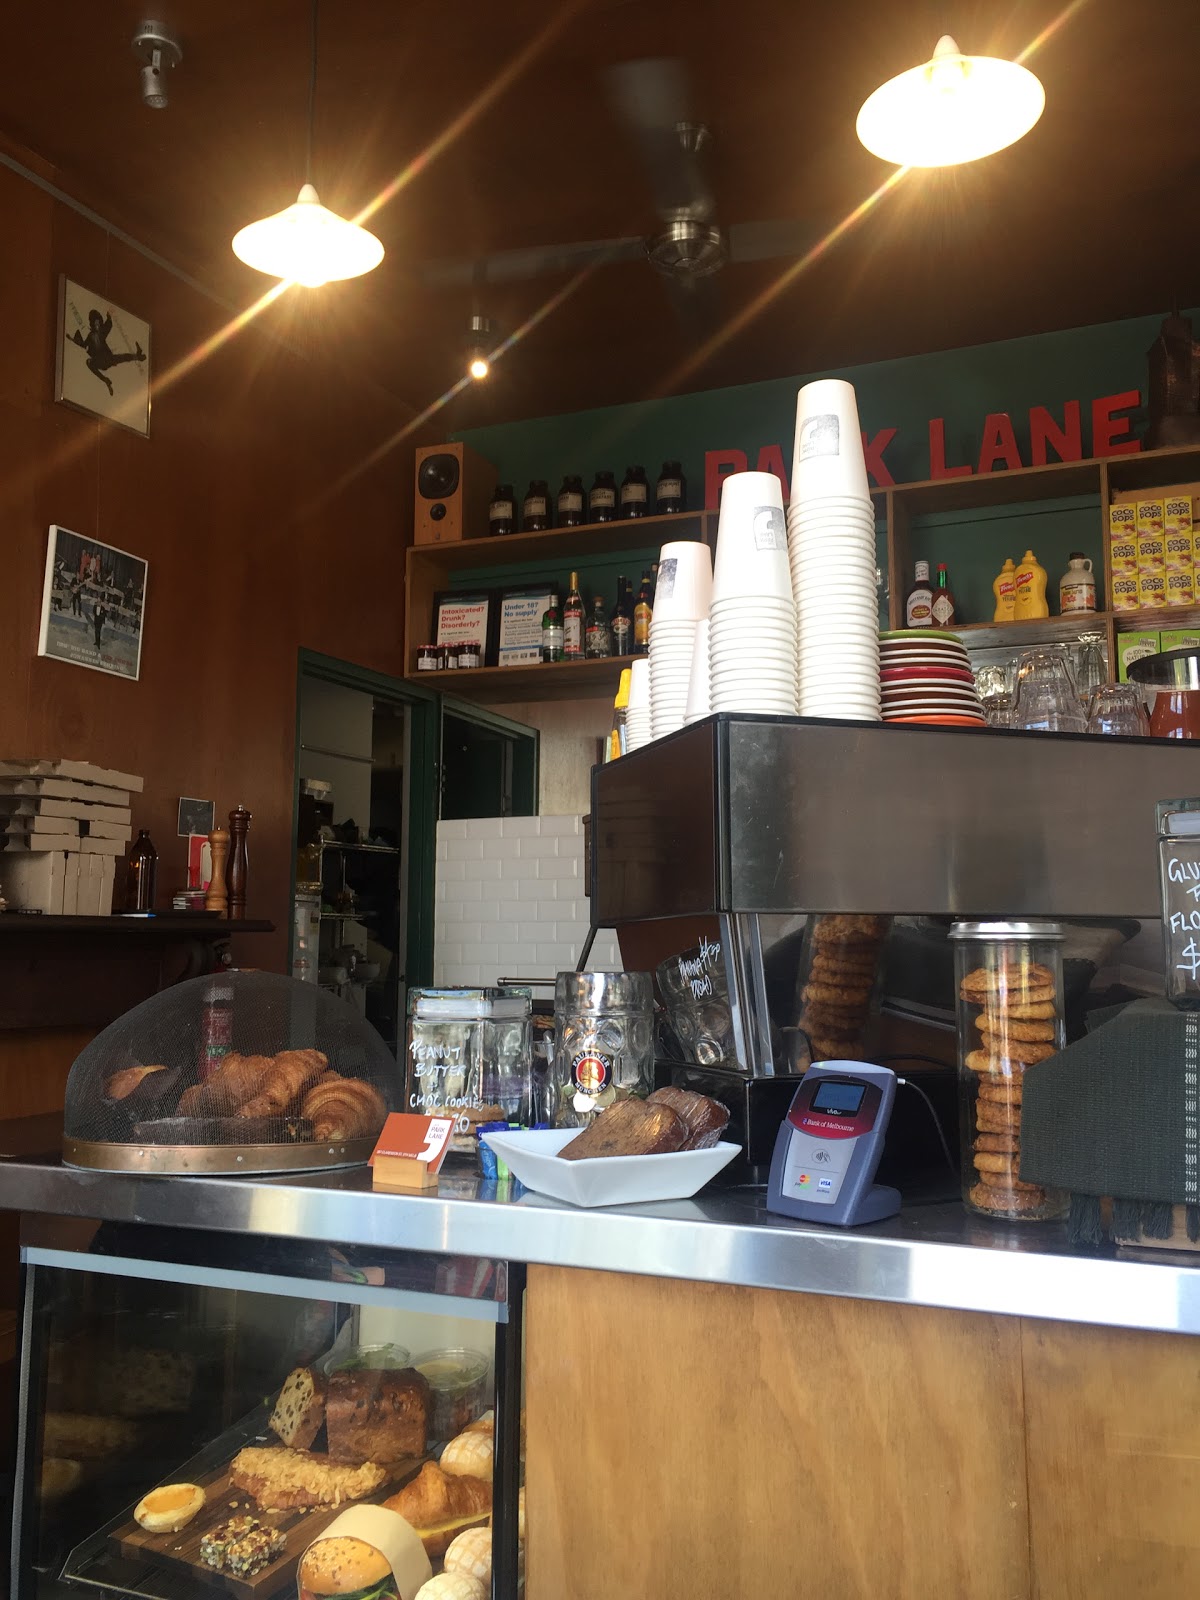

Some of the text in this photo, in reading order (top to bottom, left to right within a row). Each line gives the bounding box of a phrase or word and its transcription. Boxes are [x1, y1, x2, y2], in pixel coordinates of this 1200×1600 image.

[704, 389, 1142, 510] PAK LANE
[441, 606, 485, 615] Intoxicated?
[515, 609, 538, 617] supply
[441, 621, 480, 629] Disorderly?
[409, 1038, 460, 1060] PEANUT
[572, 1051, 610, 1068] PAULANER
[414, 1062, 467, 1078] BUTTER
[410, 1093, 440, 1108] CHOC
[807, 1118, 854, 1132] Bank of Melbourne
